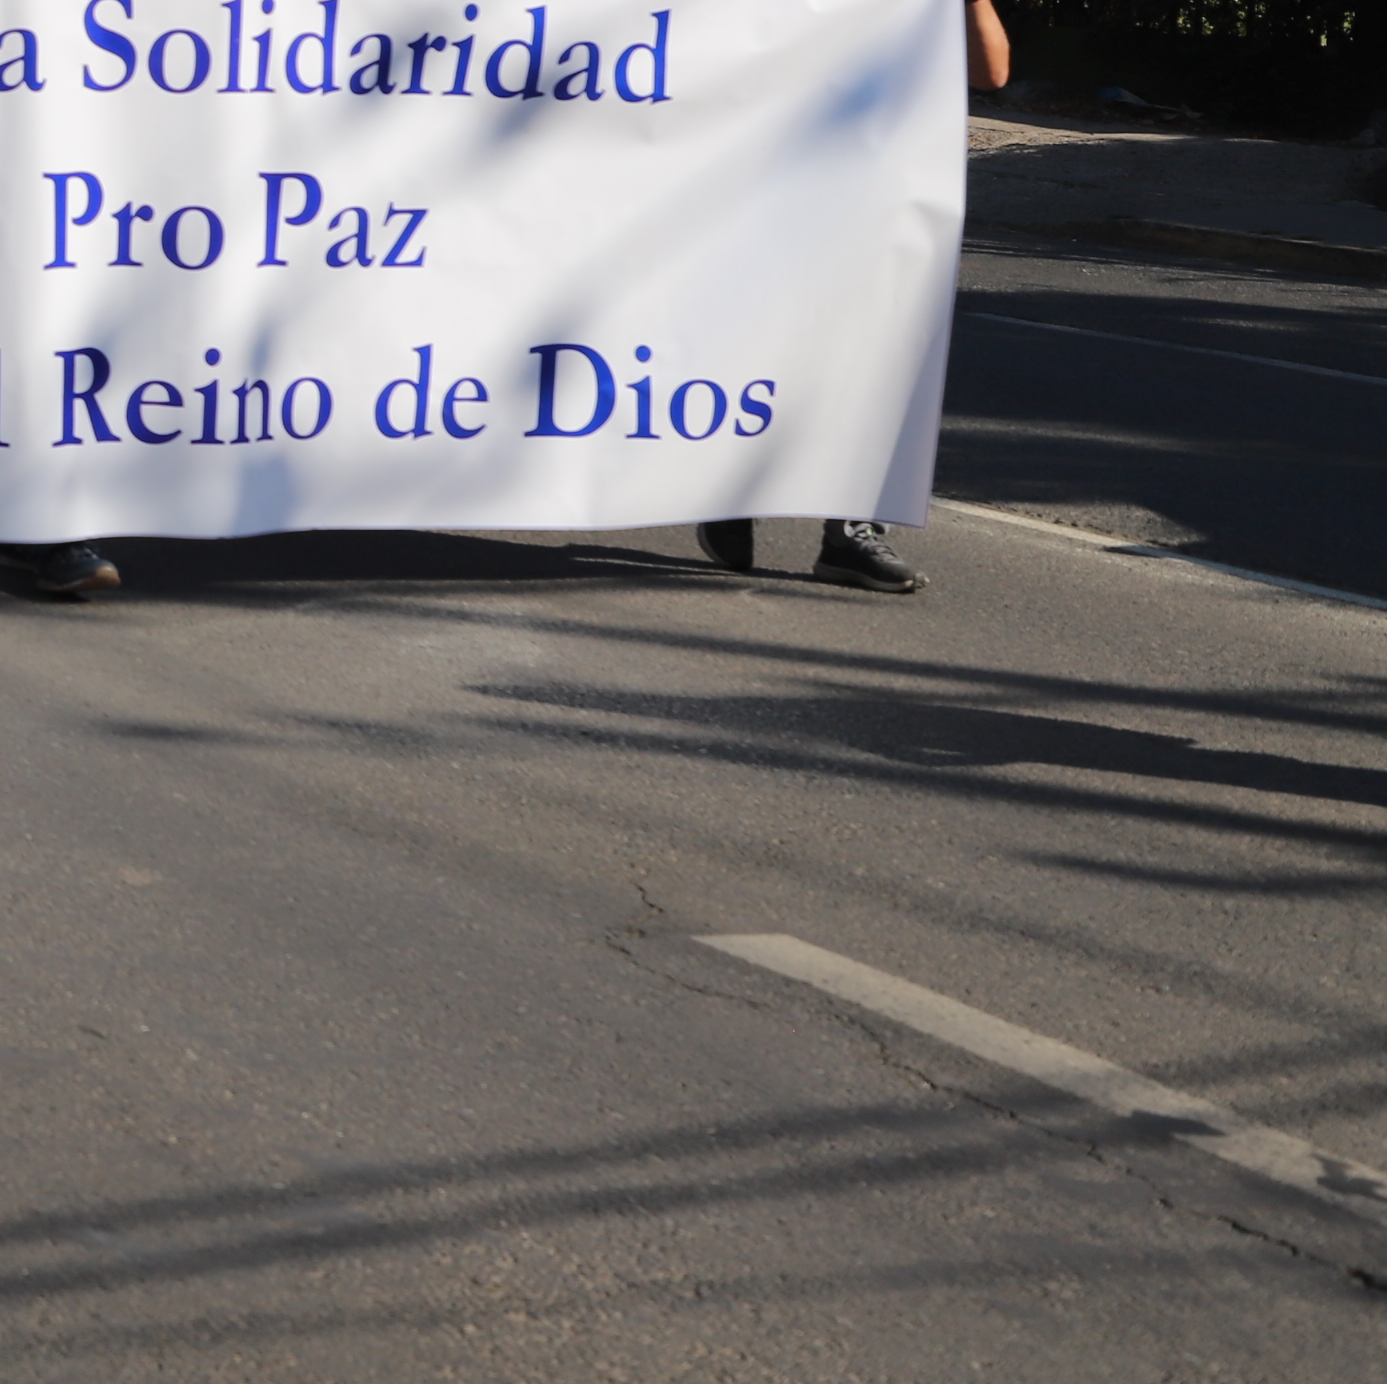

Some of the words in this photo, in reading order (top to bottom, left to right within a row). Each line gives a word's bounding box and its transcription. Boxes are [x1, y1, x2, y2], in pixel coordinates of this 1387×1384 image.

[43, 172, 225, 270] Pro
[258, 173, 428, 268] Paz
[53, 347, 333, 447] Reino
[374, 345, 489, 440] de
[525, 344, 776, 441] Dios
